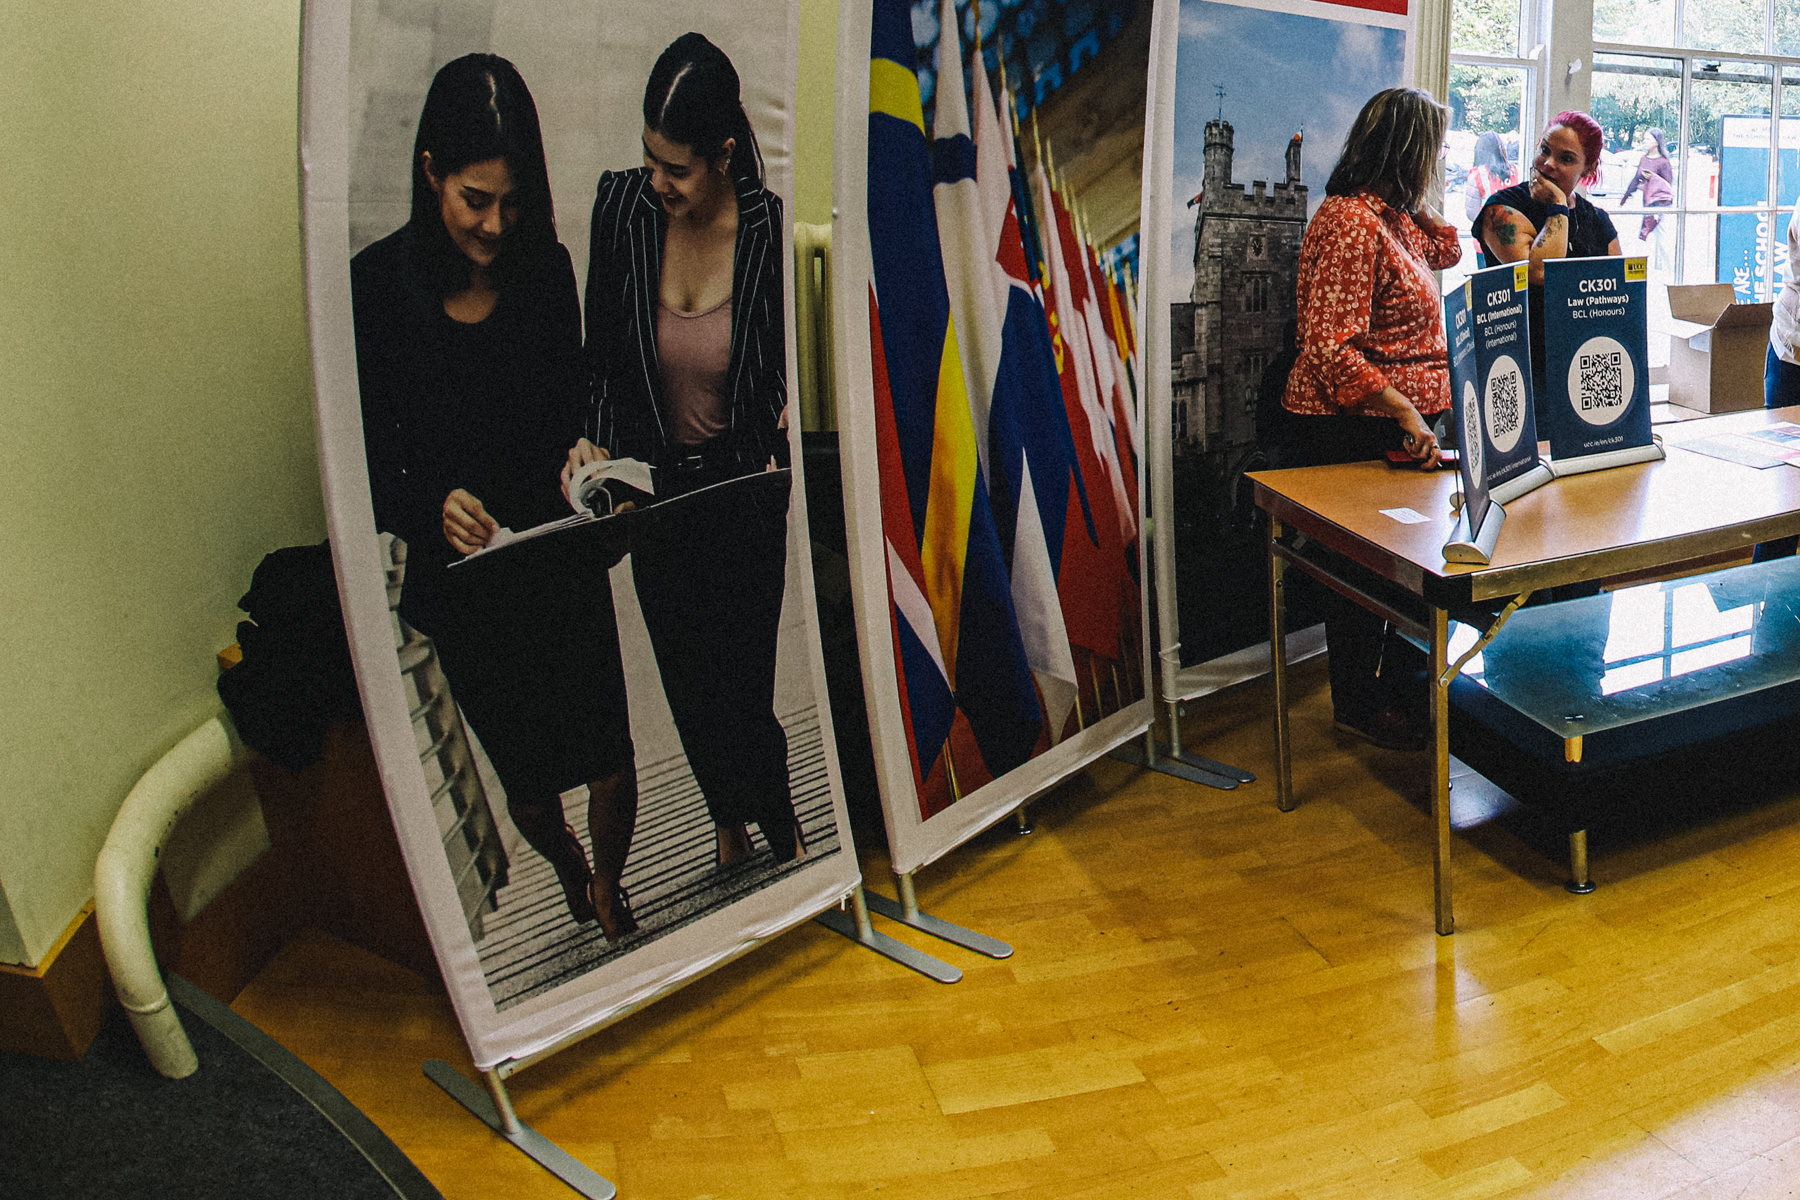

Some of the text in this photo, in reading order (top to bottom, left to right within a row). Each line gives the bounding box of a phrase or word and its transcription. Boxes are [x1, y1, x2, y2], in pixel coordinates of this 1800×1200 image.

[1579, 278, 1617, 293] CK301
[1487, 288, 1511, 307] CK301
[1567, 294, 1629, 307] Law (Pathways)
[1476, 303, 1523, 324] BCL (International)
[1572, 306, 1625, 319] BCL (Honours)
[1484, 320, 1517, 337] BCL (Honours)
[1485, 332, 1518, 349] (International)
